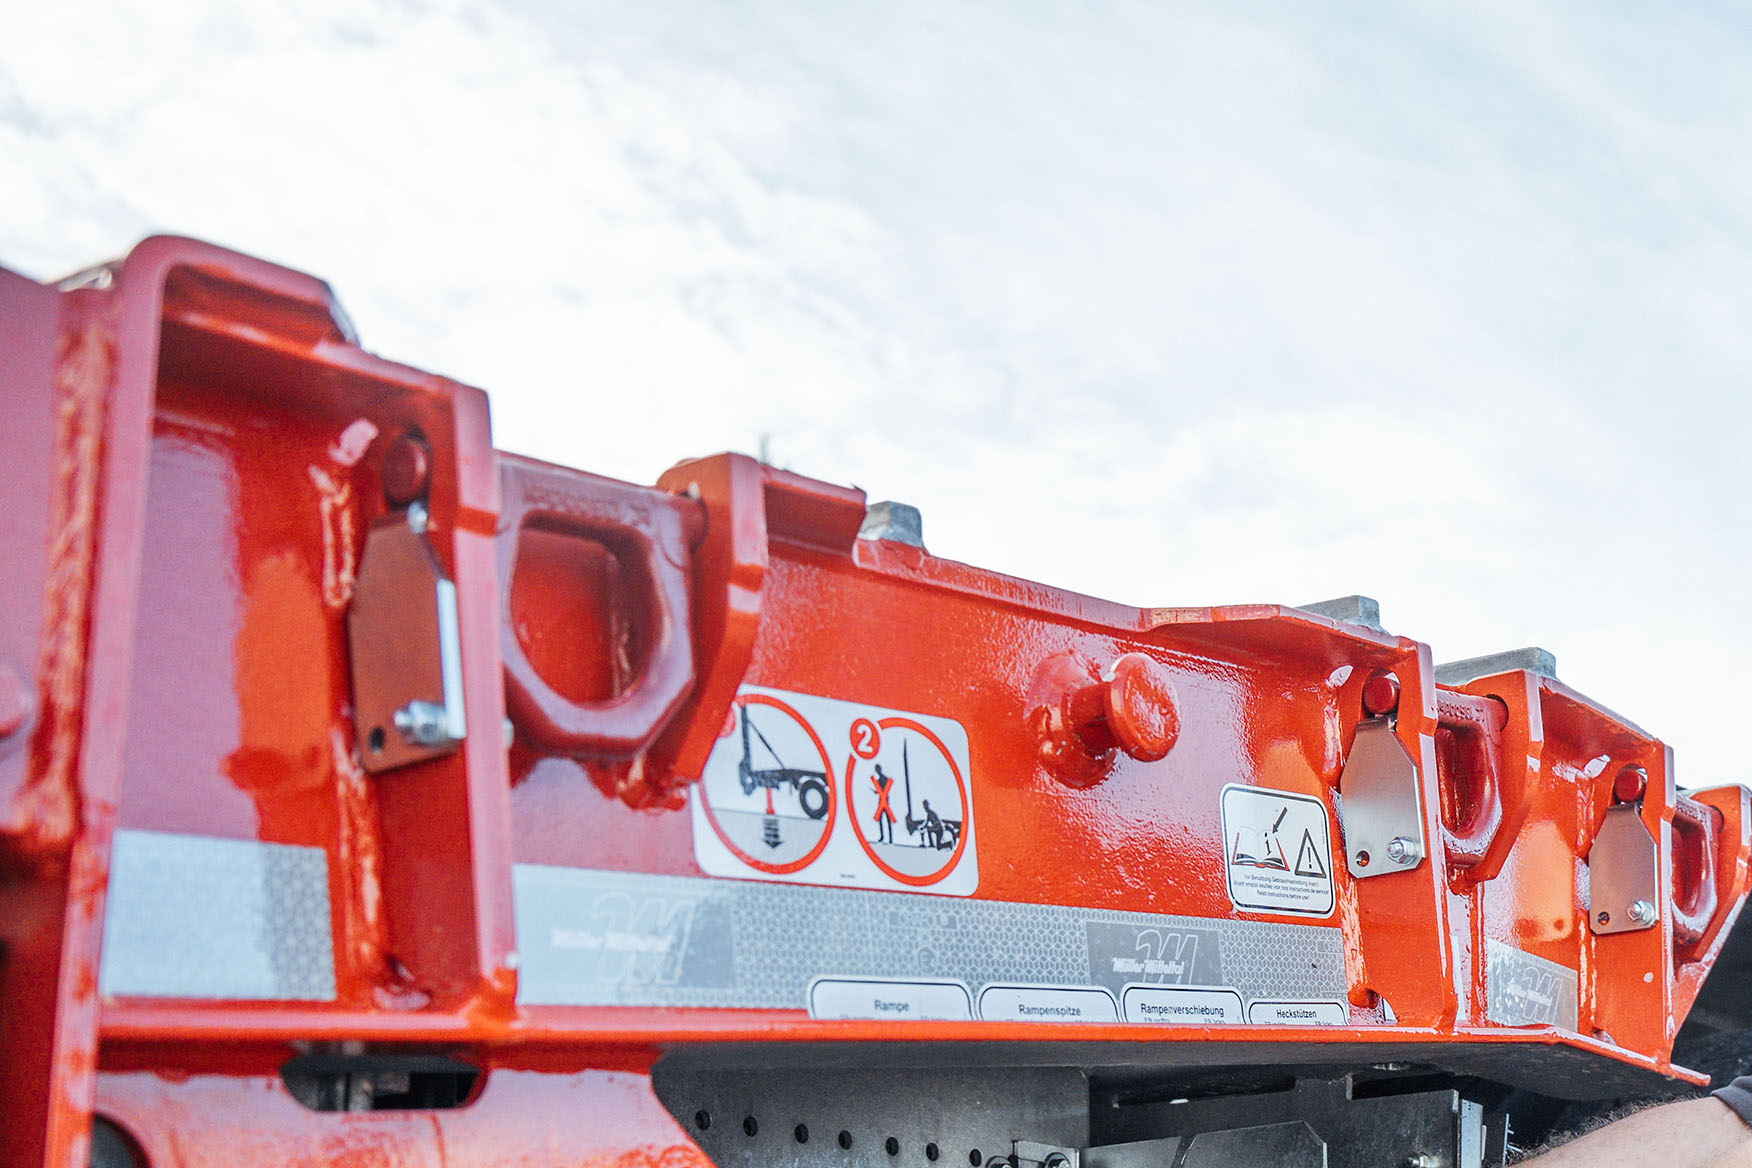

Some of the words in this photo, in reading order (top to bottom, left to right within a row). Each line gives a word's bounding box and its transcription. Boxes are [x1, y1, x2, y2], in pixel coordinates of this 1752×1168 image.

[858, 724, 873, 753] 2
[874, 999, 910, 1012] Rampe
[1018, 1004, 1081, 1018] Rampenspitze
[1276, 1009, 1317, 1019] Heckstützen
